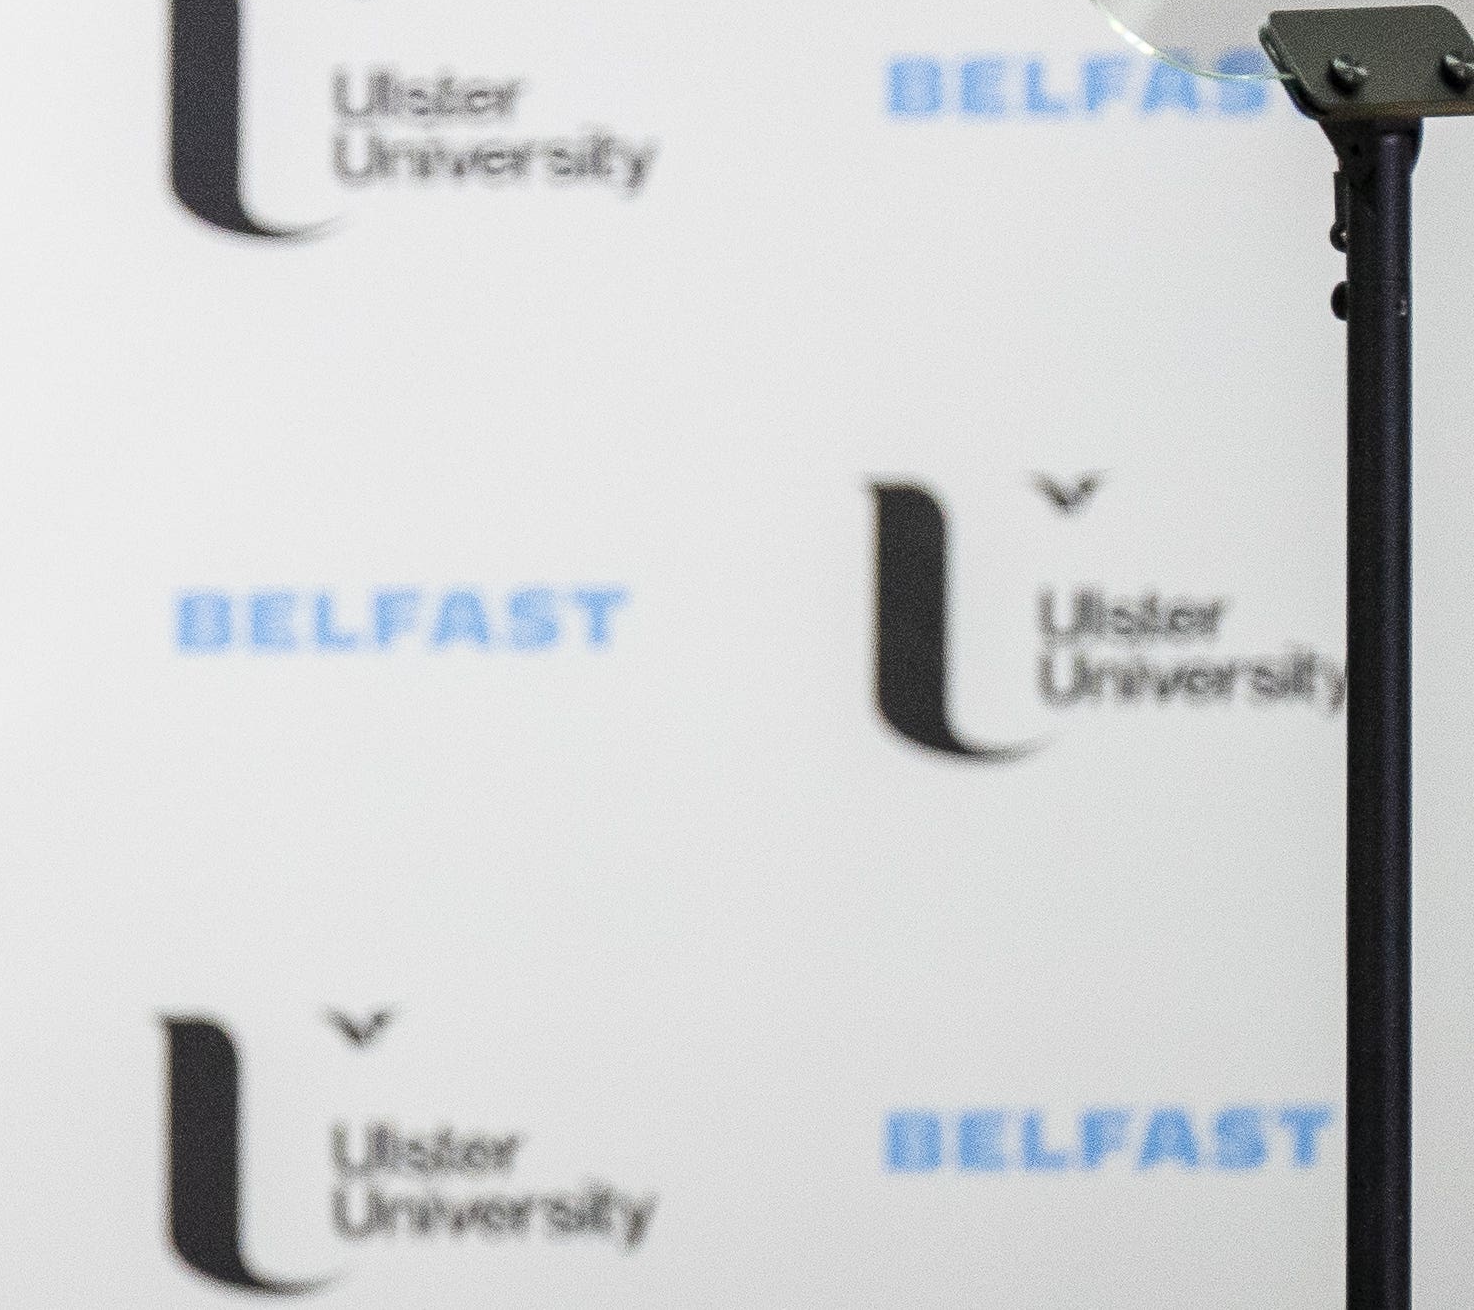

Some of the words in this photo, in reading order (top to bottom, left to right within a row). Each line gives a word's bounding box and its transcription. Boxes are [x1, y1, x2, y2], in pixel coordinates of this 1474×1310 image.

[332, 67, 521, 121] Ulster
[882, 46, 1273, 121] BELFAS
[332, 132, 654, 191] University
[172, 584, 629, 655] BELFAST
[330, 1122, 522, 1178] Ulster
[880, 1102, 1335, 1175] BELFAST
[330, 1185, 655, 1248] University
